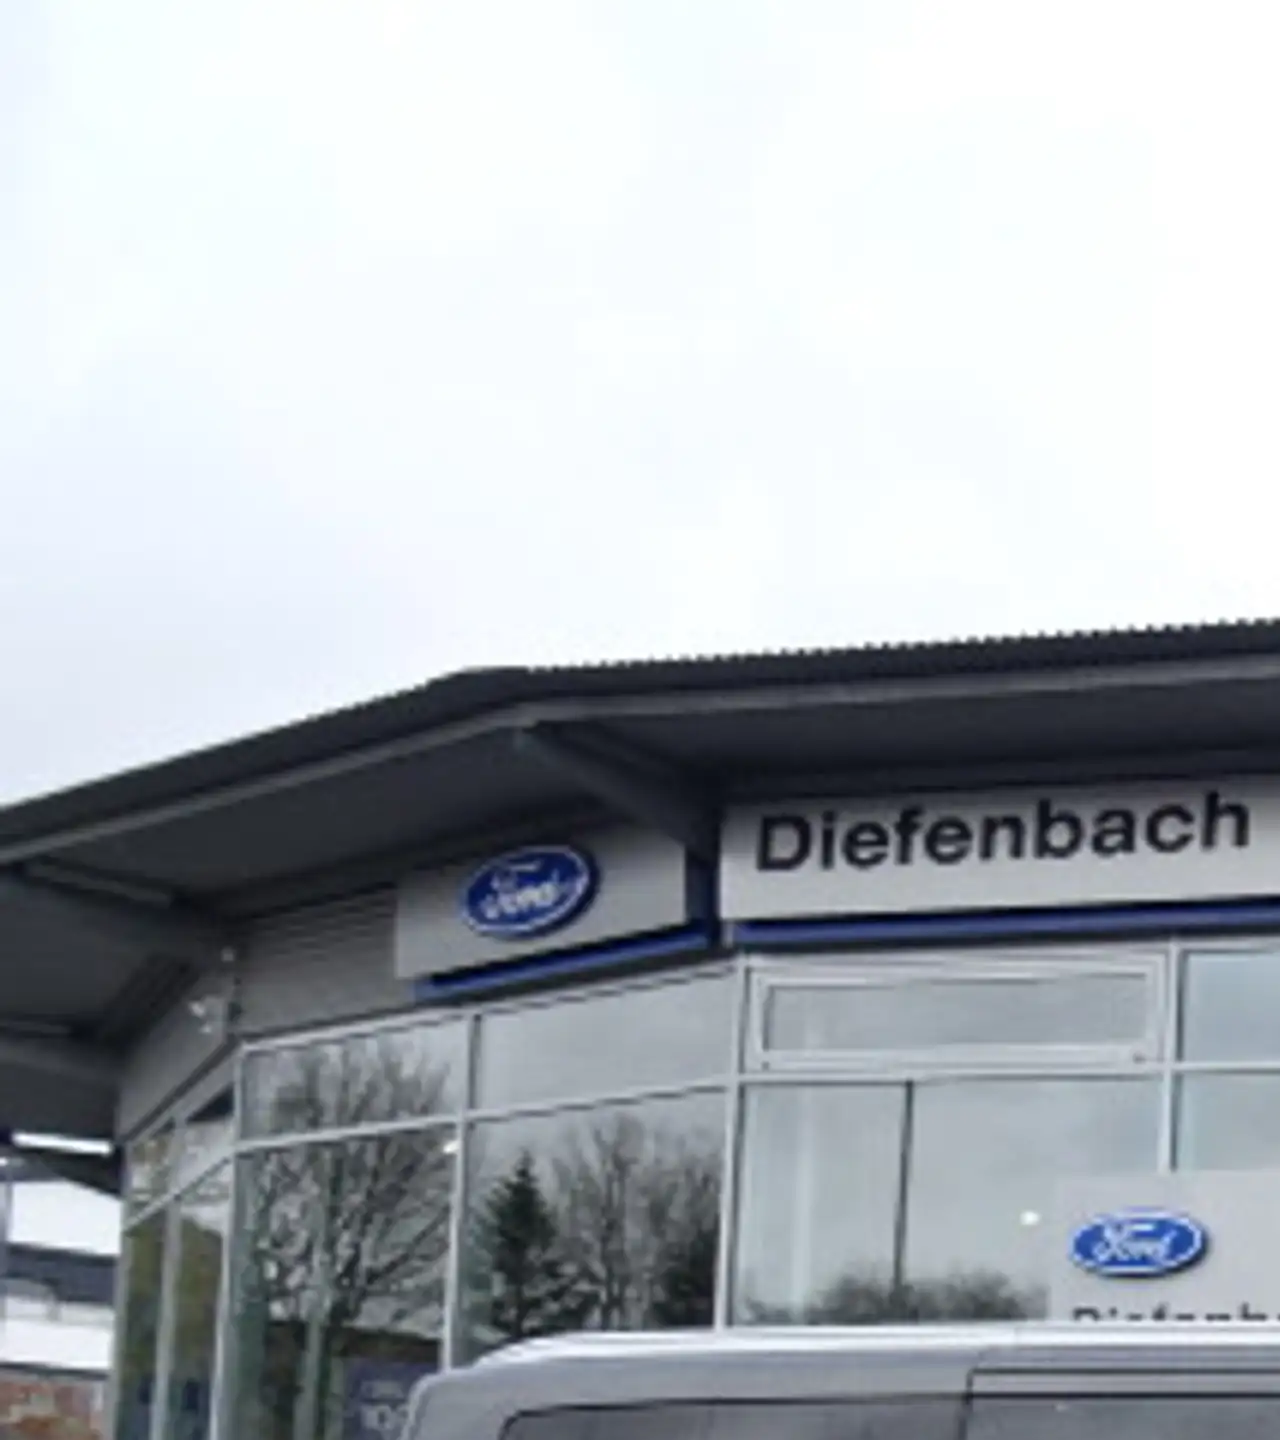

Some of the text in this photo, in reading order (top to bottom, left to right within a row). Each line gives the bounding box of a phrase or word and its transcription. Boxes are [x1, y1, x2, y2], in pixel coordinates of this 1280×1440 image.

[756, 790, 1250, 872] Diefenbach
[480, 857, 567, 920] Ford
[1091, 1221, 1178, 1261] Ford
